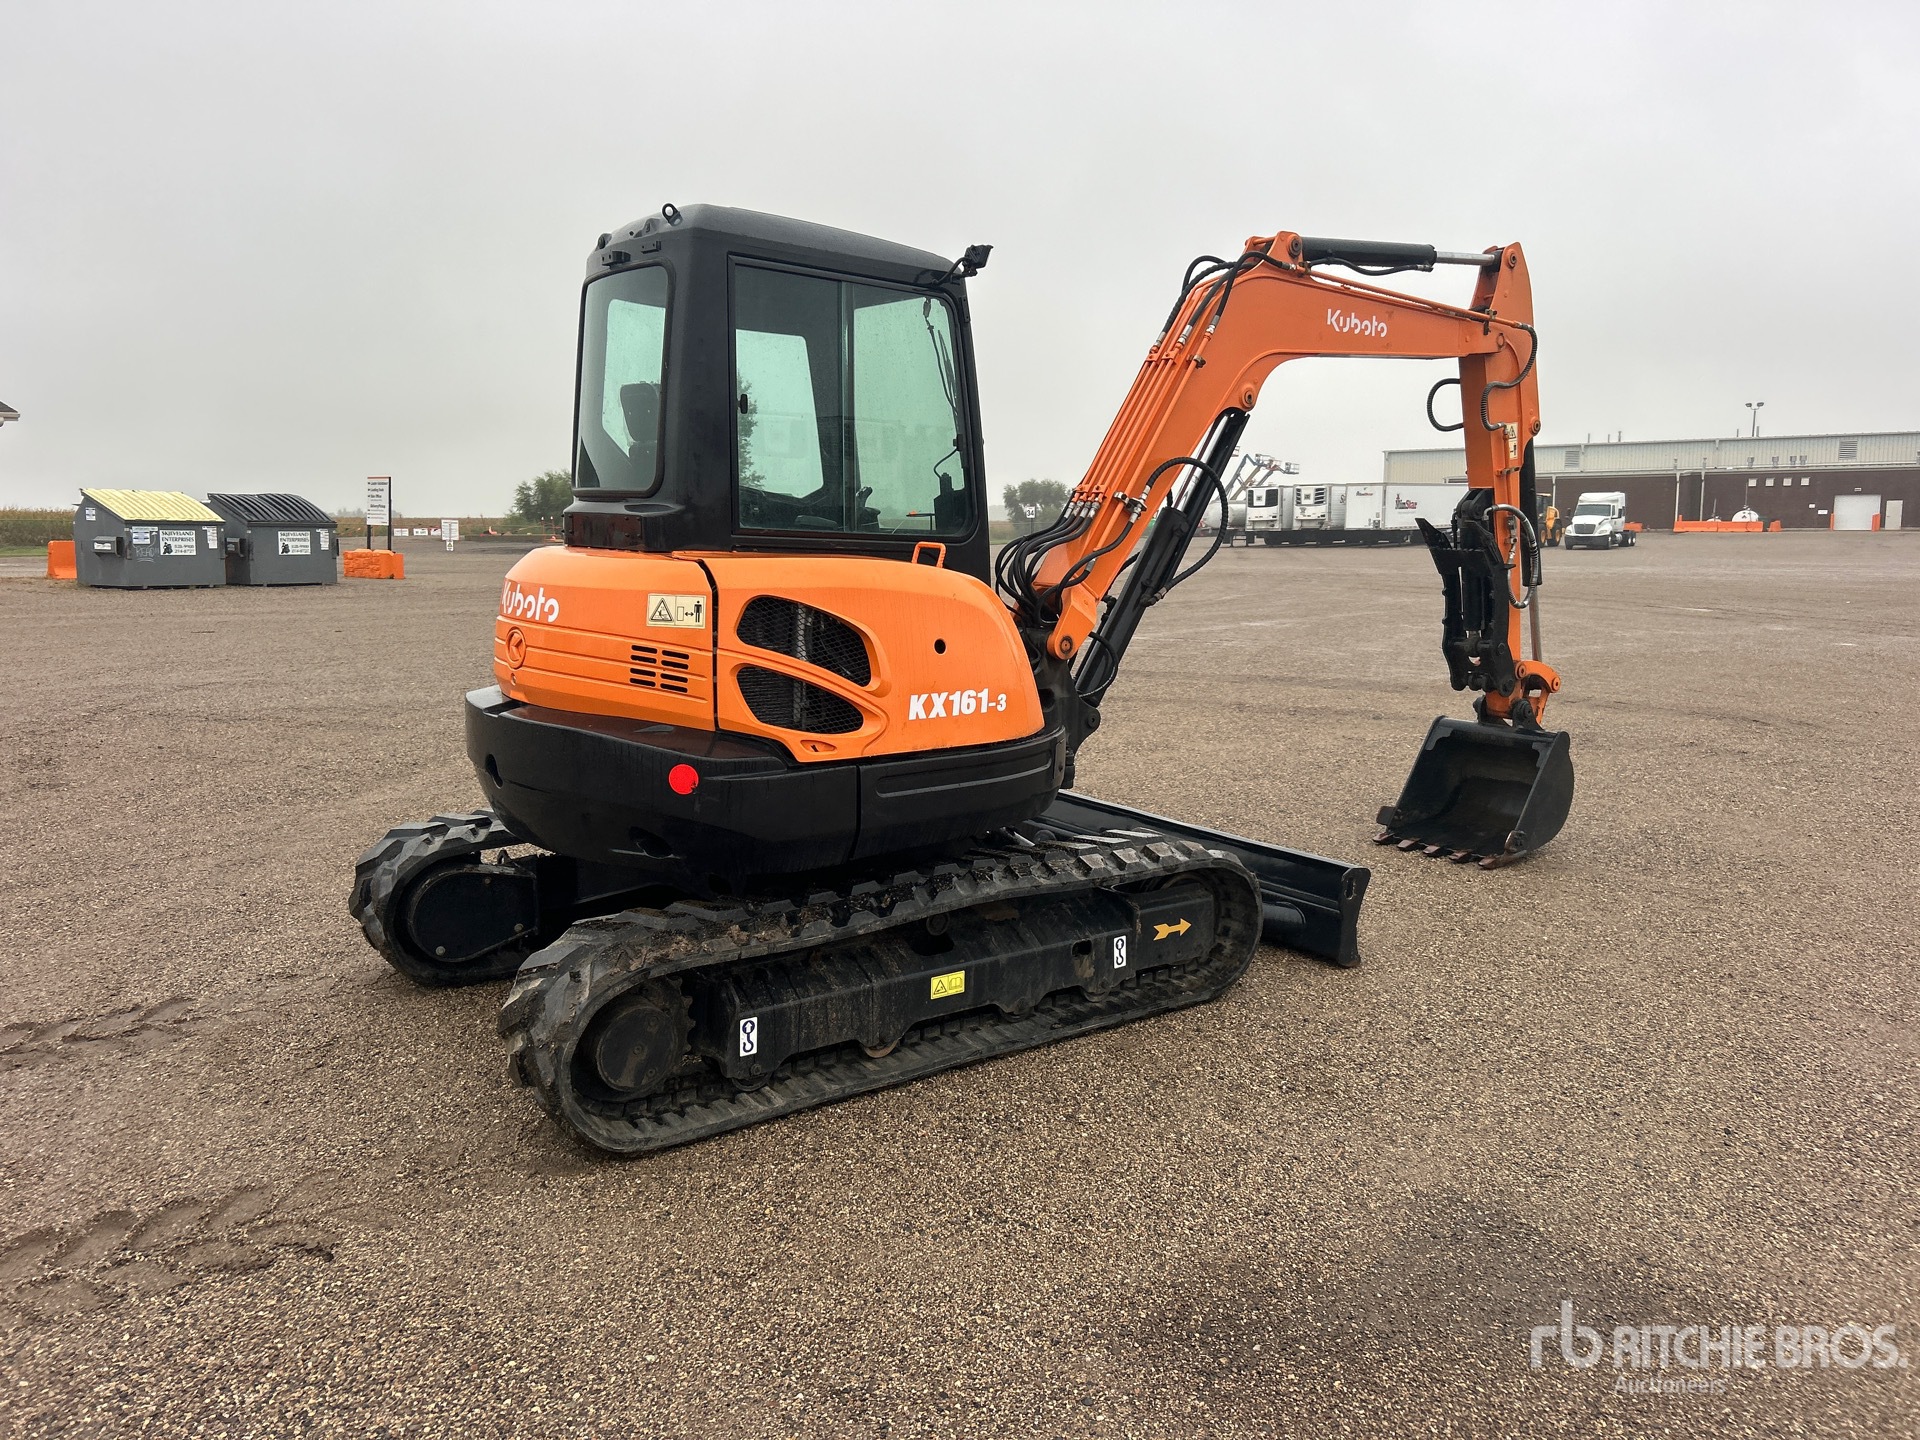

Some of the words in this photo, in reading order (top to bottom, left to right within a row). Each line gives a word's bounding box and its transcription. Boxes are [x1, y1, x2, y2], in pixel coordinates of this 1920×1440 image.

[1326, 308, 1388, 338] Kubota
[501, 580, 560, 623] Kubota
[908, 687, 1007, 720] KX161-3
